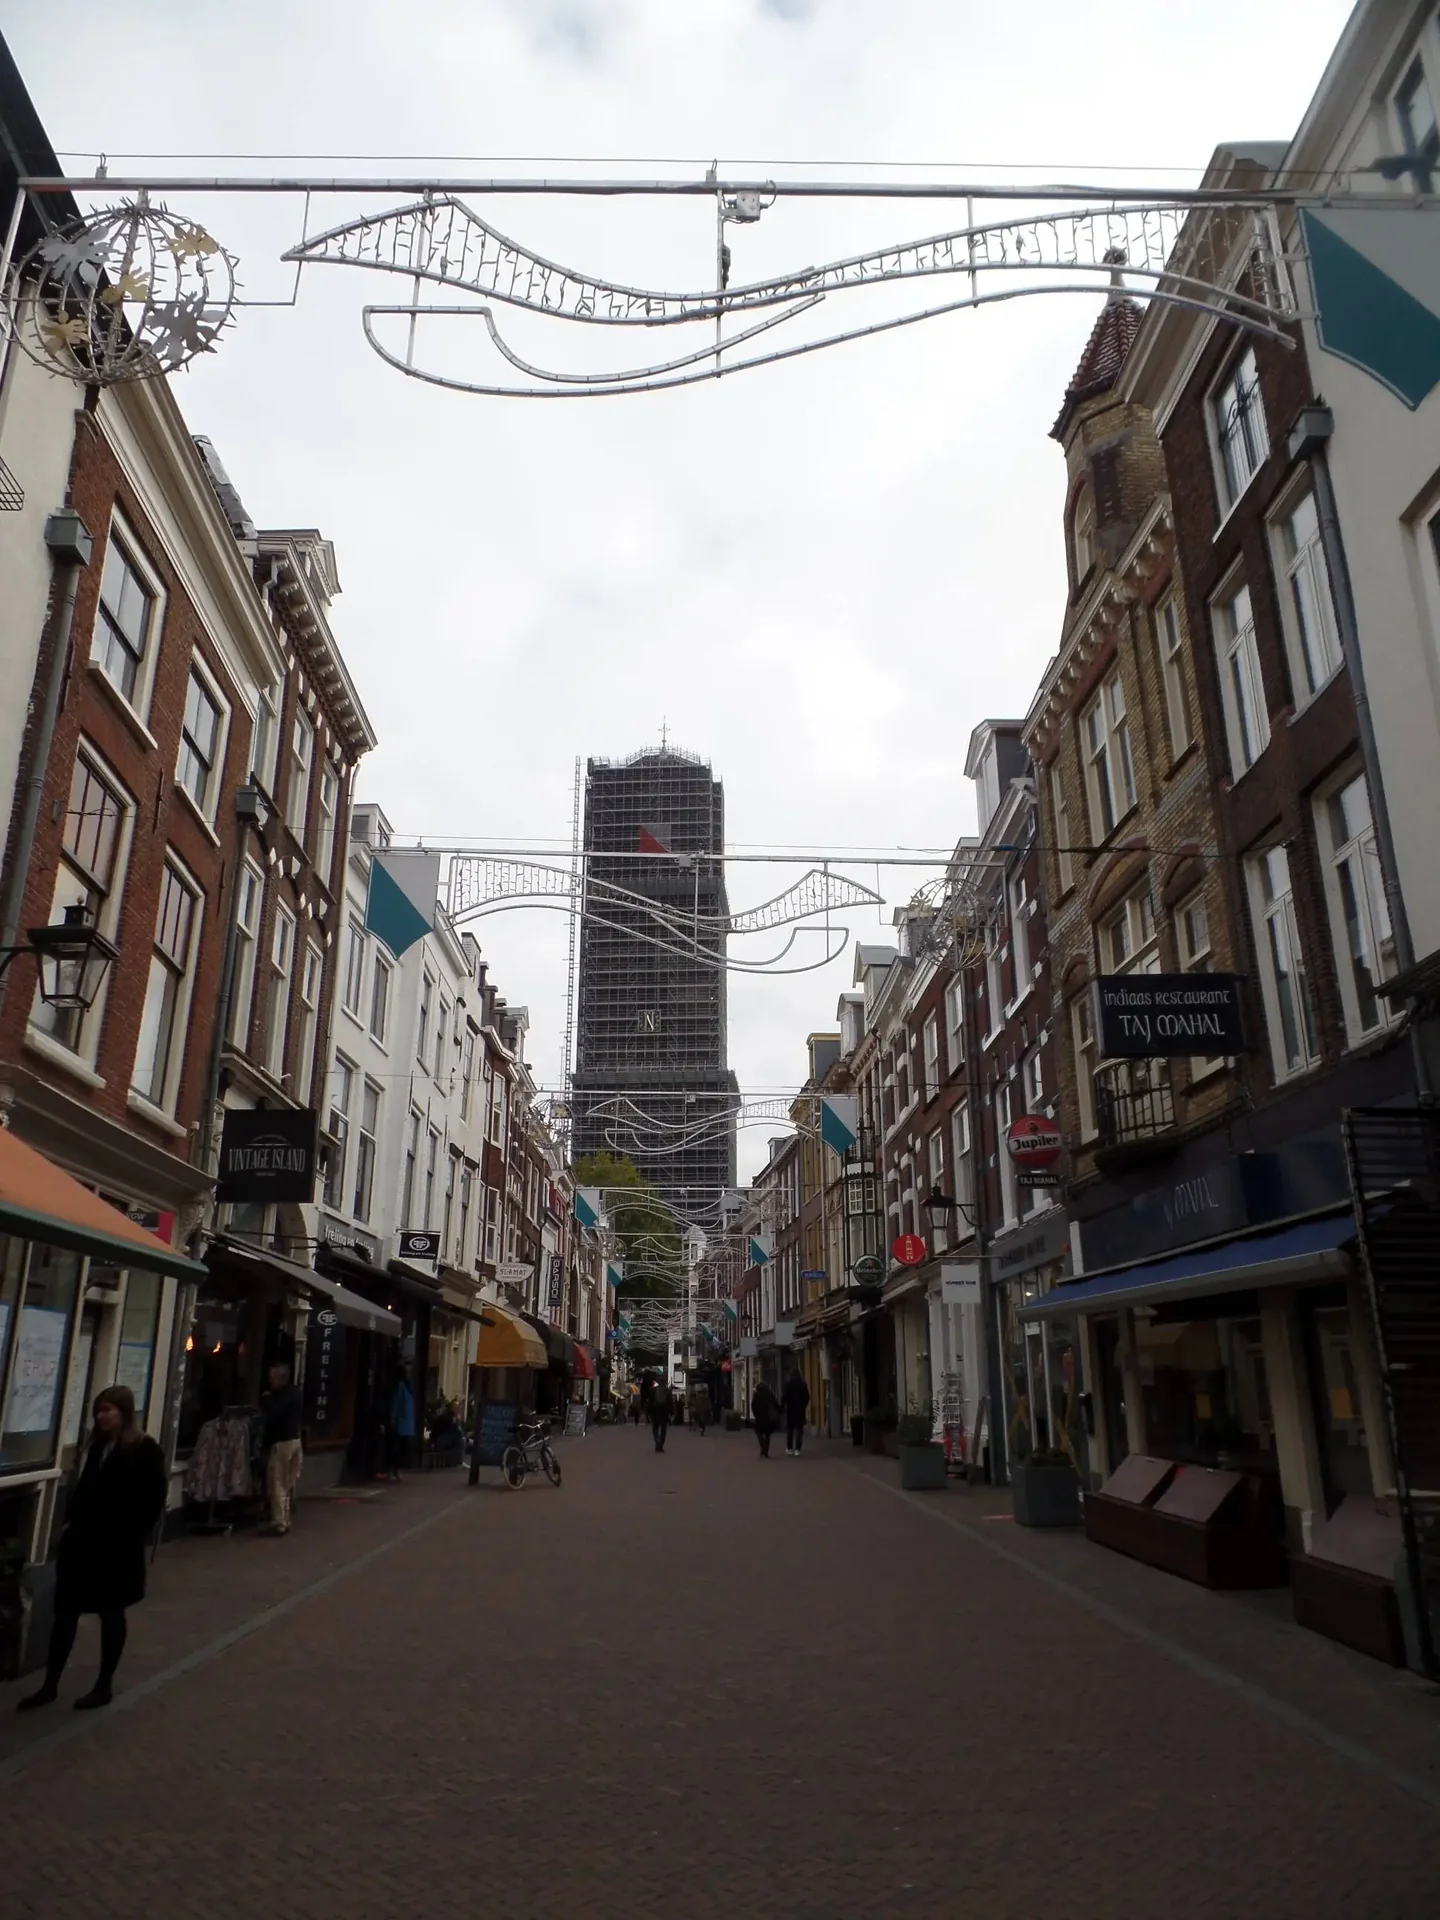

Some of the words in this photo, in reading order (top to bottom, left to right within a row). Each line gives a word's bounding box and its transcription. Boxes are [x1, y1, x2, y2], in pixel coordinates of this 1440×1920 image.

[1118, 1015, 1151, 1044] TAJ
[1156, 1013, 1226, 1036] MAHAL
[1014, 1135, 1059, 1150] Jupiler
[228, 1148, 271, 1172] VINTAGE
[271, 1148, 306, 1172] ISLAND
[1020, 1176, 1033, 1184] TAJ
[1033, 1176, 1059, 1184] MAHAL
[316, 1327, 333, 1420] FRELING
